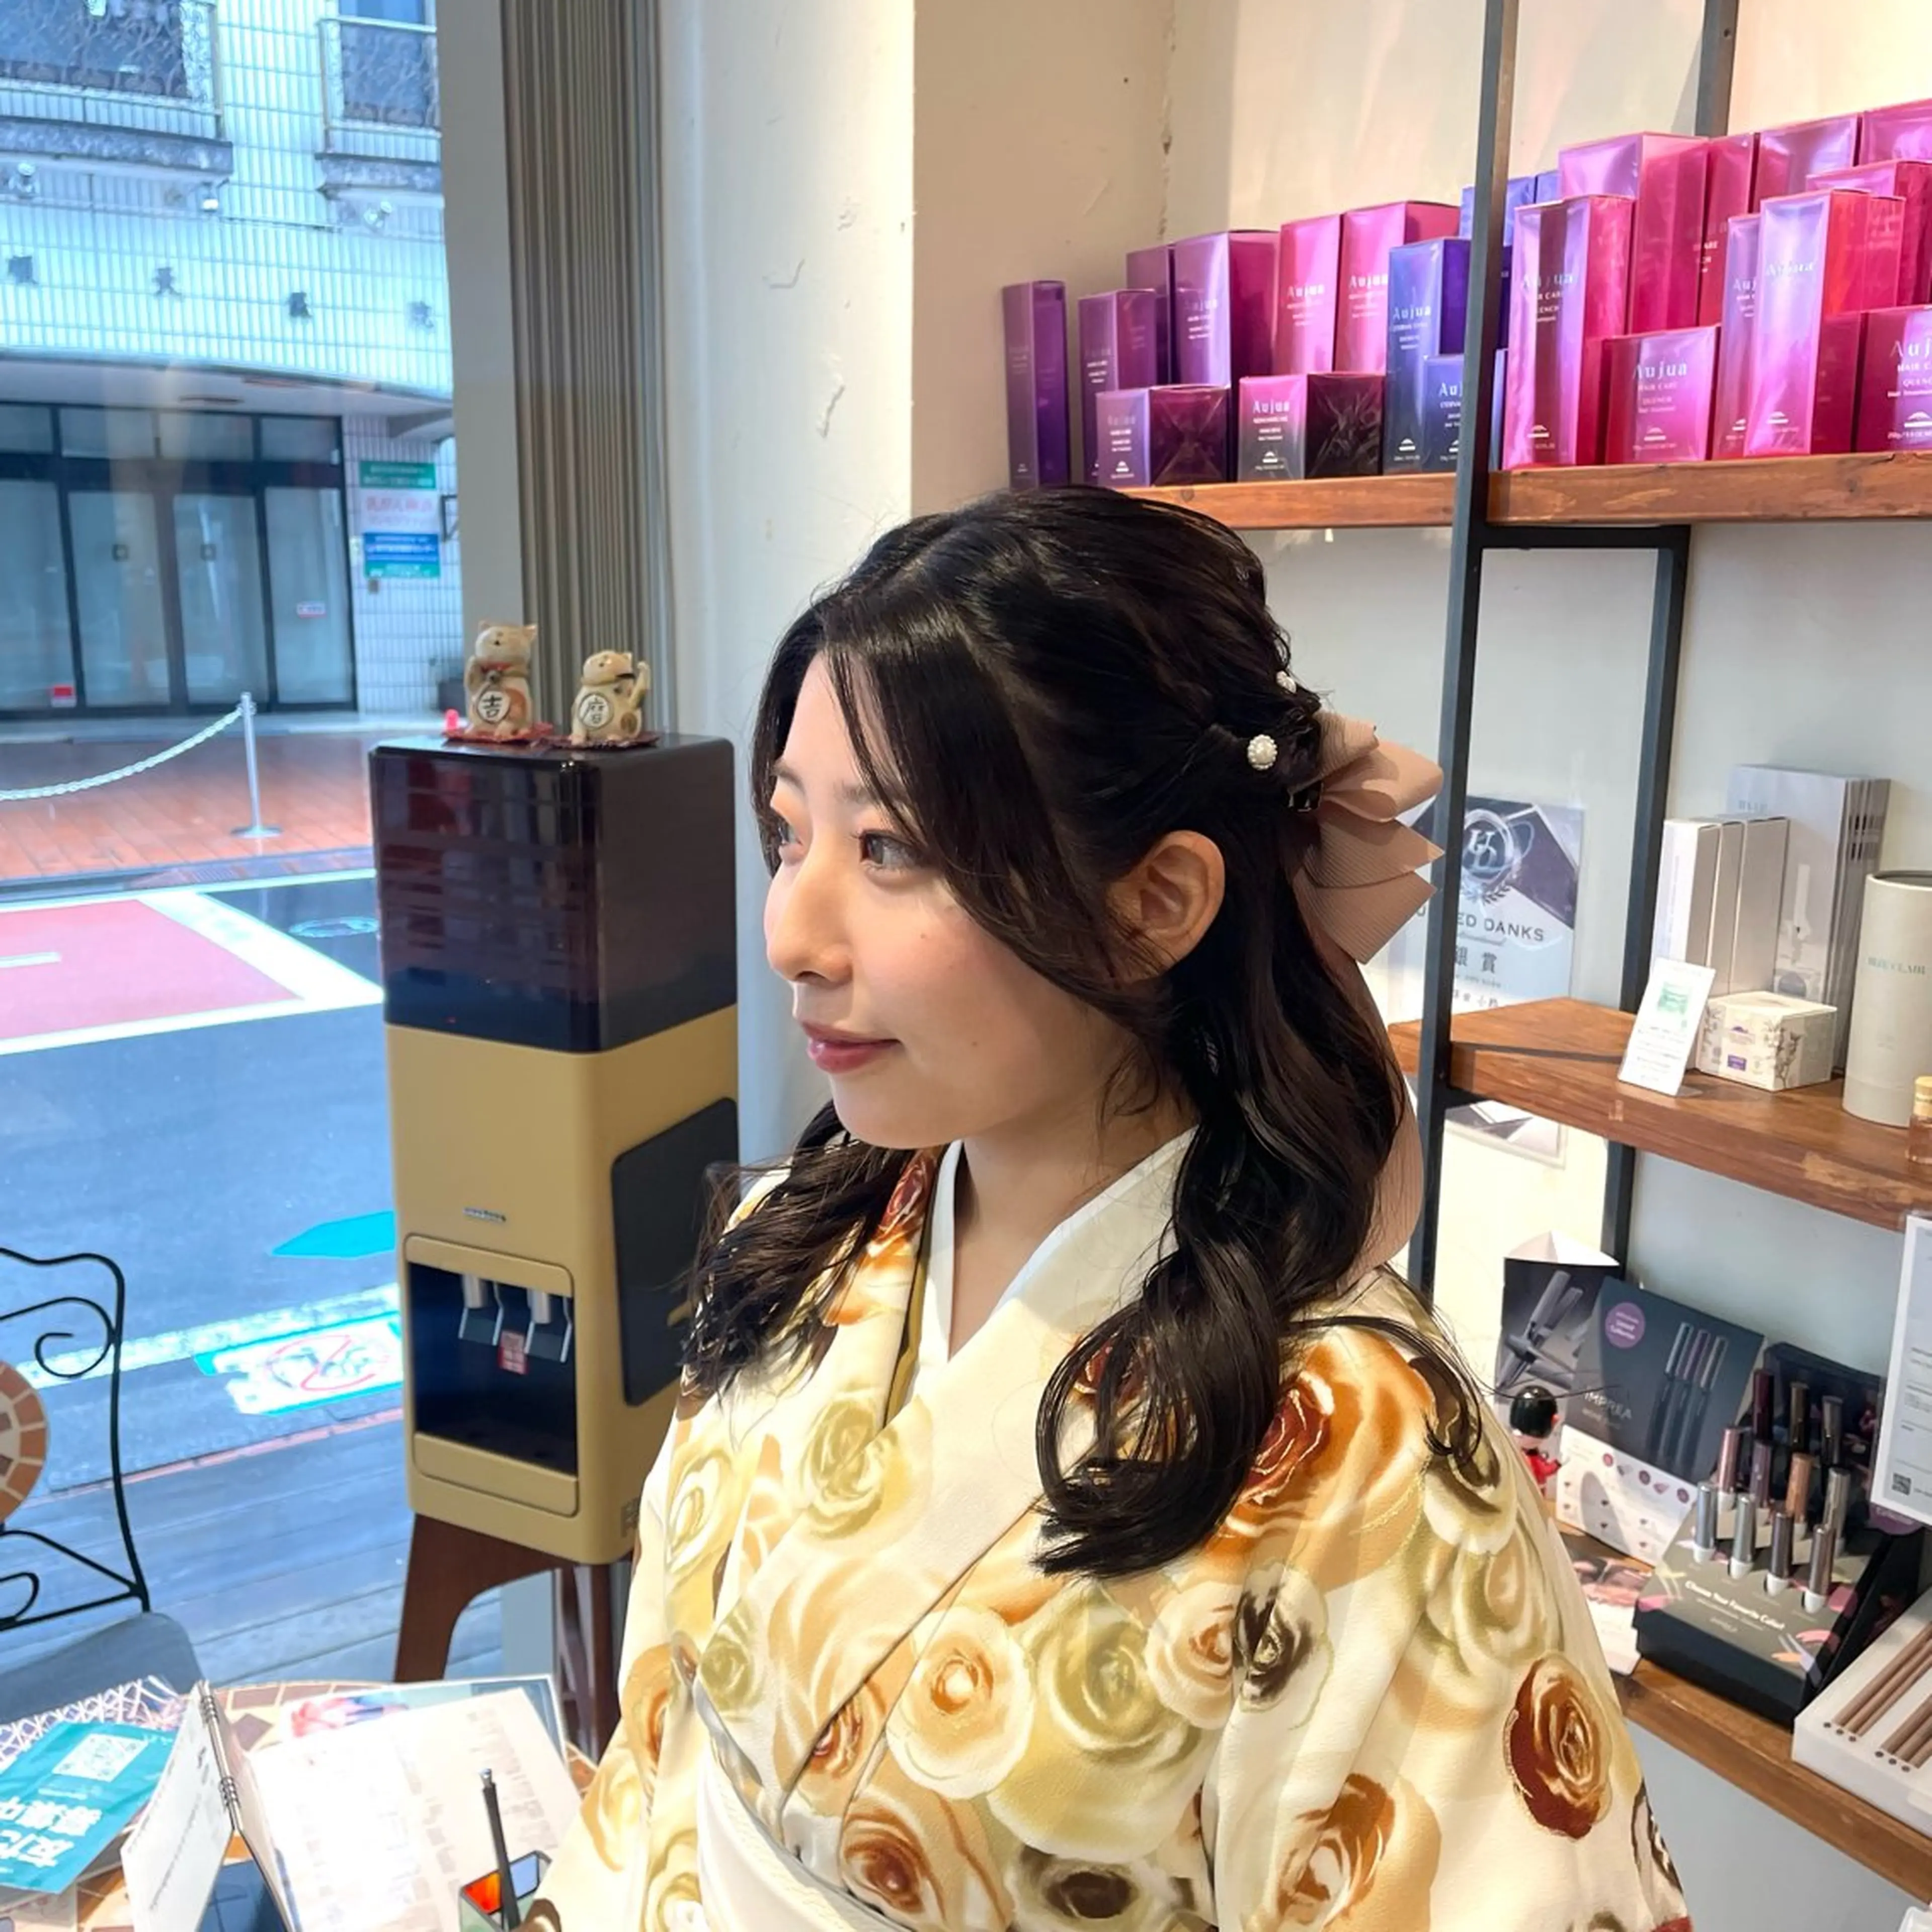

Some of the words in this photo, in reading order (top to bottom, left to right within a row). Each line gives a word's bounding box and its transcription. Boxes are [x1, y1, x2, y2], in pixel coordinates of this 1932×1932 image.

[1633, 361, 1687, 380] Aujua
[1253, 400, 1290, 414] Aujua
[482, 694, 502, 718] 吉
[1484, 918, 1545, 941] DANKS
